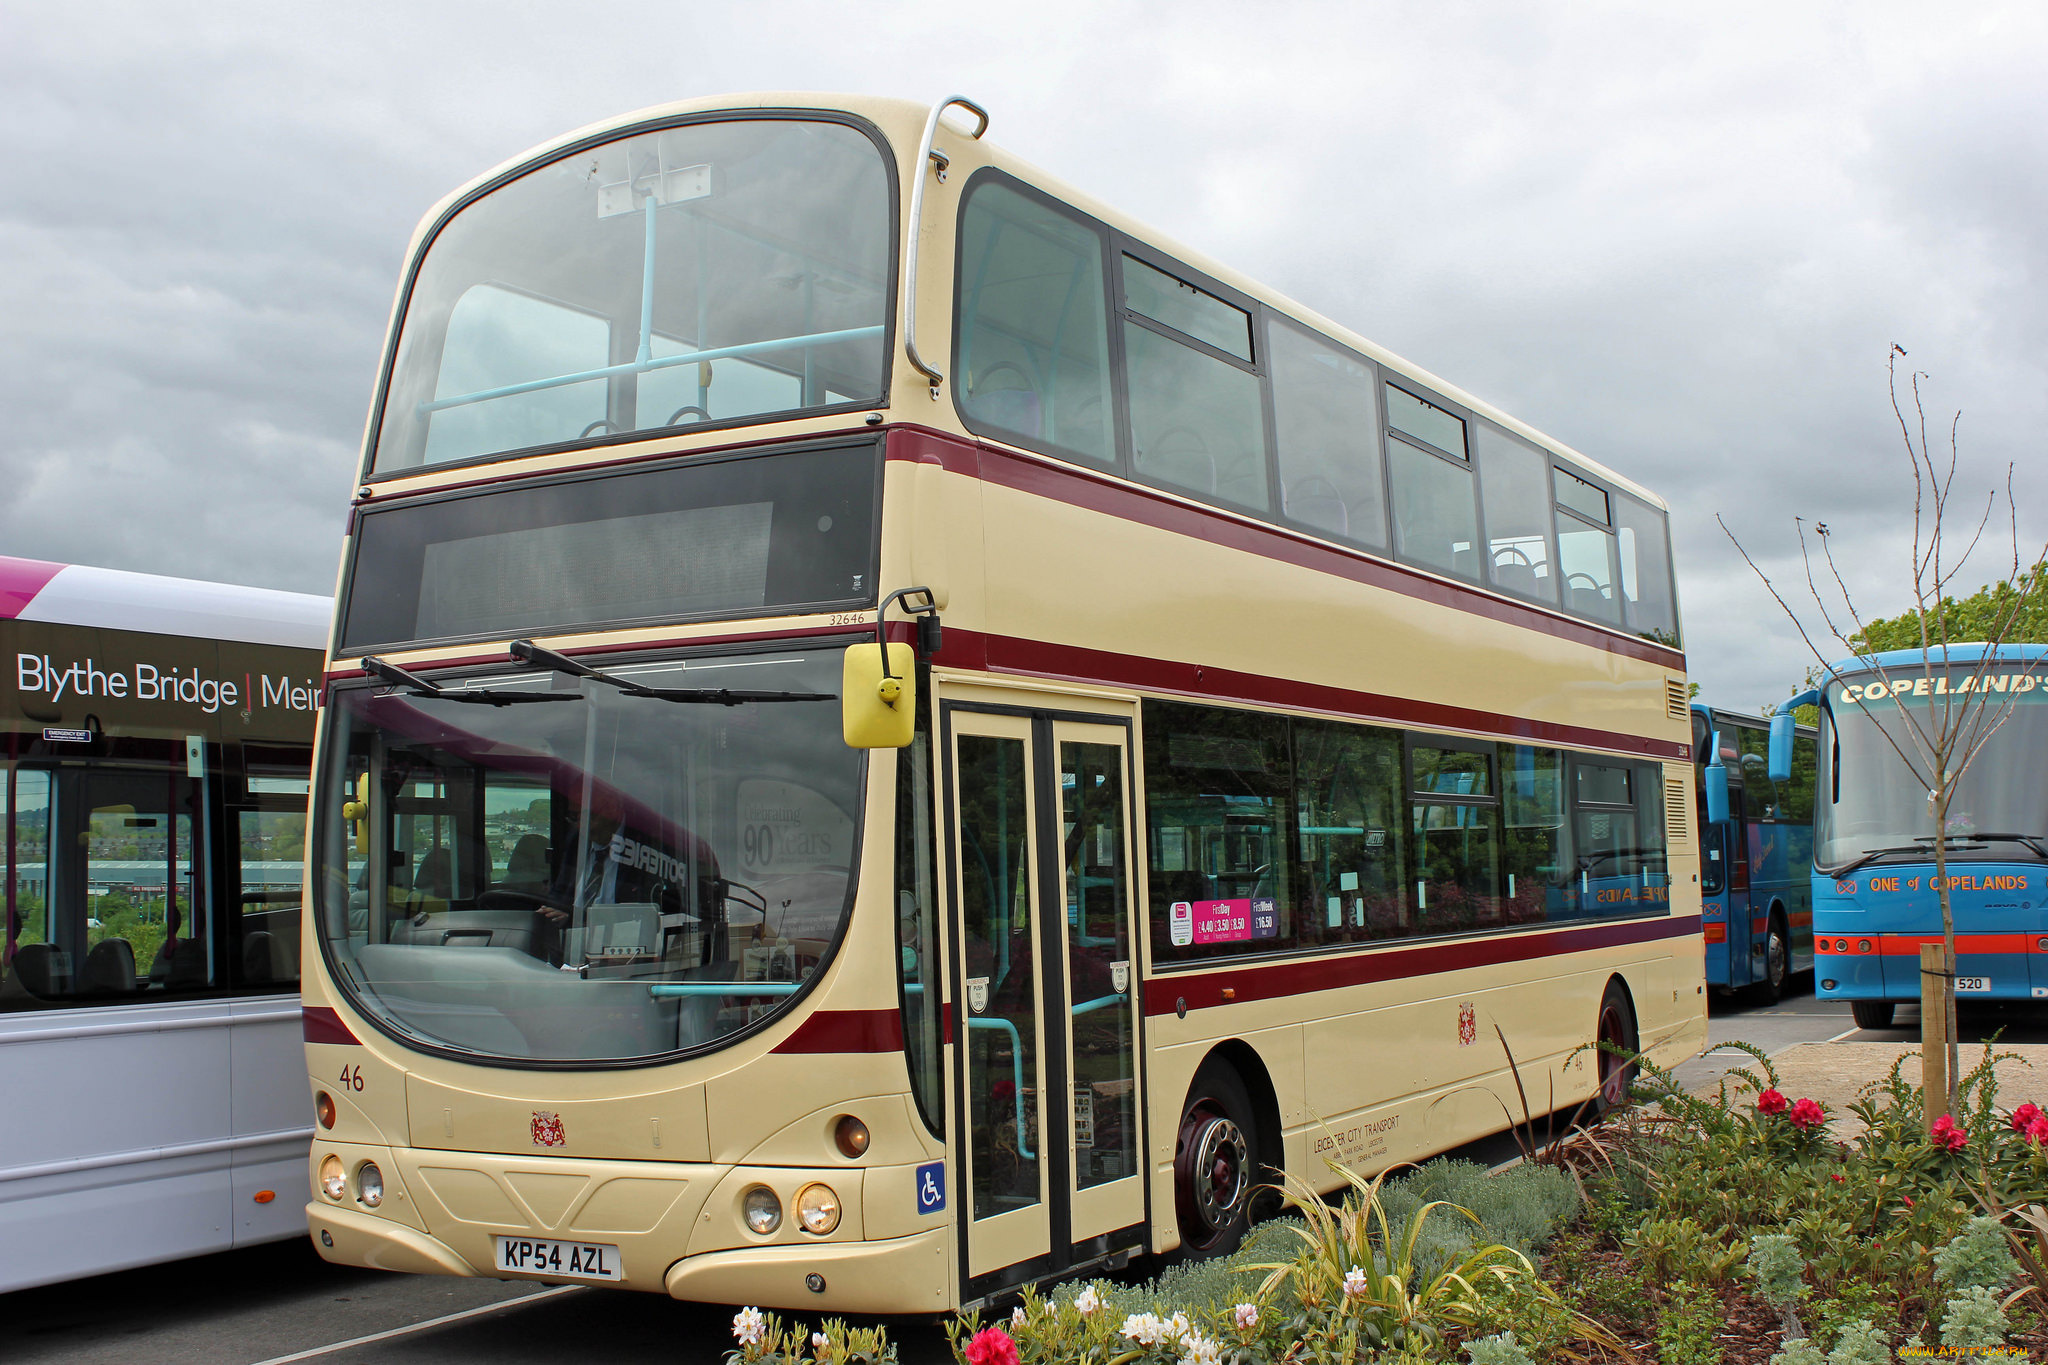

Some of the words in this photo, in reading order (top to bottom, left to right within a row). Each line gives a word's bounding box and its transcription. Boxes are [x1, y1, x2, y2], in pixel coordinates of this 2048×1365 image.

[830, 613, 864, 626] 32646
[17, 653, 128, 702] Blythe
[136, 663, 238, 714] Bridge
[744, 824, 773, 866] 90
[1870, 877, 1900, 892] ONE
[1906, 876, 1920, 891] of
[1958, 978, 1982, 989] 520
[340, 1064, 364, 1092] 46
[1313, 1132, 1346, 1154] LEICESTER
[1347, 1126, 1362, 1142] CITY
[1364, 1115, 1400, 1137] TRANSPORT
[506, 1240, 562, 1270] KP54
[569, 1246, 612, 1275] AZL
